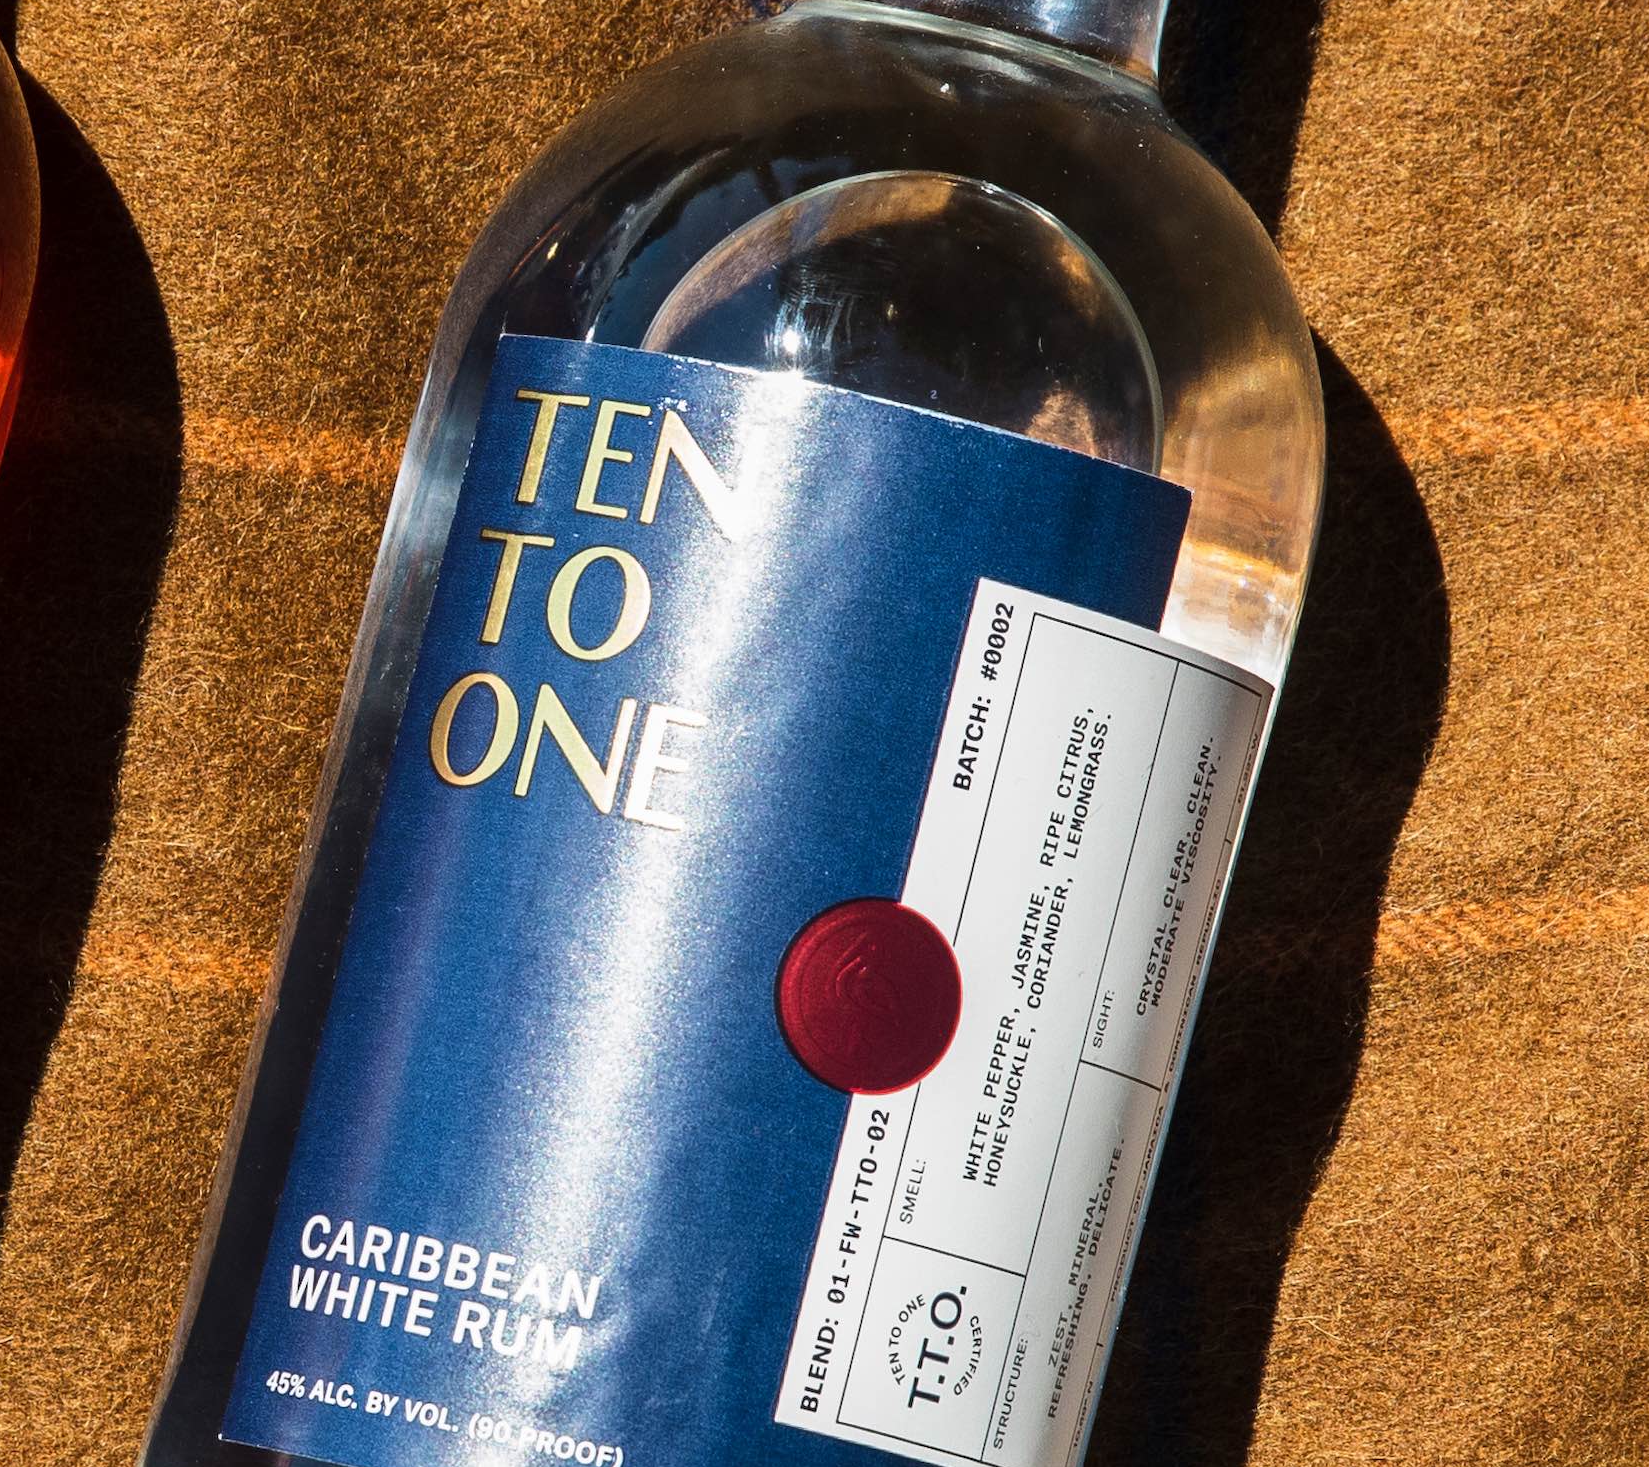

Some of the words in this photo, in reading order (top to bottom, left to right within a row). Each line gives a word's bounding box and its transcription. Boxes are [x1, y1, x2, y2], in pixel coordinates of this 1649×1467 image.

[515, 389, 769, 545] TEN
[480, 528, 652, 661] TO
[430, 672, 709, 832] ONE
[951, 693, 992, 791] BATCH:
[978, 600, 1014, 681] #0002
[1134, 921, 1167, 1016] CRYSTAL
[1161, 829, 1191, 909] CLEAR,
[1185, 735, 1214, 814] CLEAN.
[1150, 898, 1185, 1007] MODERATE
[1180, 754, 1222, 885] VISCOSITY.
[961, 1111, 993, 1182] WHITE
[982, 1003, 1021, 1099] PEPPER,
[1008, 880, 1051, 990] JASMINE,
[1038, 810, 1066, 867] RIPE
[1055, 703, 1095, 800] CITRUS,
[981, 1023, 1037, 1187] HONEYSUCKLE,
[1025, 873, 1074, 1011] CORIANDER,
[1062, 710, 1113, 859] LEMONGRASS.
[1091, 988, 1115, 1049] SIGHT:
[1109, 1217, 1135, 1303] PRODUCT
[1140, 1104, 1164, 1181] JAMAICA
[1168, 974, 1197, 1072] DOMINICAN
[1195, 878, 1222, 965] REPUBLIC
[898, 1157, 927, 1224] SMELL:
[1087, 1136, 1125, 1257] DELICATE.
[289, 1264, 438, 1337] WHITE
[453, 1300, 583, 1371] RUM
[301, 1214, 600, 1319] CARIBBEAN
[799, 1315, 840, 1413] BLEND:
[824, 1107, 891, 1306] 01-FW-TTO-02
[896, 1289, 928, 1326] ONE
[882, 1350, 912, 1386] TEN
[887, 1324, 903, 1348] TO
[906, 1278, 968, 1414] T.T.O.
[950, 1313, 990, 1398] CERTIFIED
[991, 1337, 1029, 1449] STRUCTURE:
[1046, 1302, 1072, 1368] ZEST,
[266, 1371, 305, 1398] 45%
[309, 1381, 357, 1410] ALC.
[366, 1390, 398, 1416] BY
[404, 1401, 459, 1432] VOL.
[468, 1412, 509, 1444] (90
